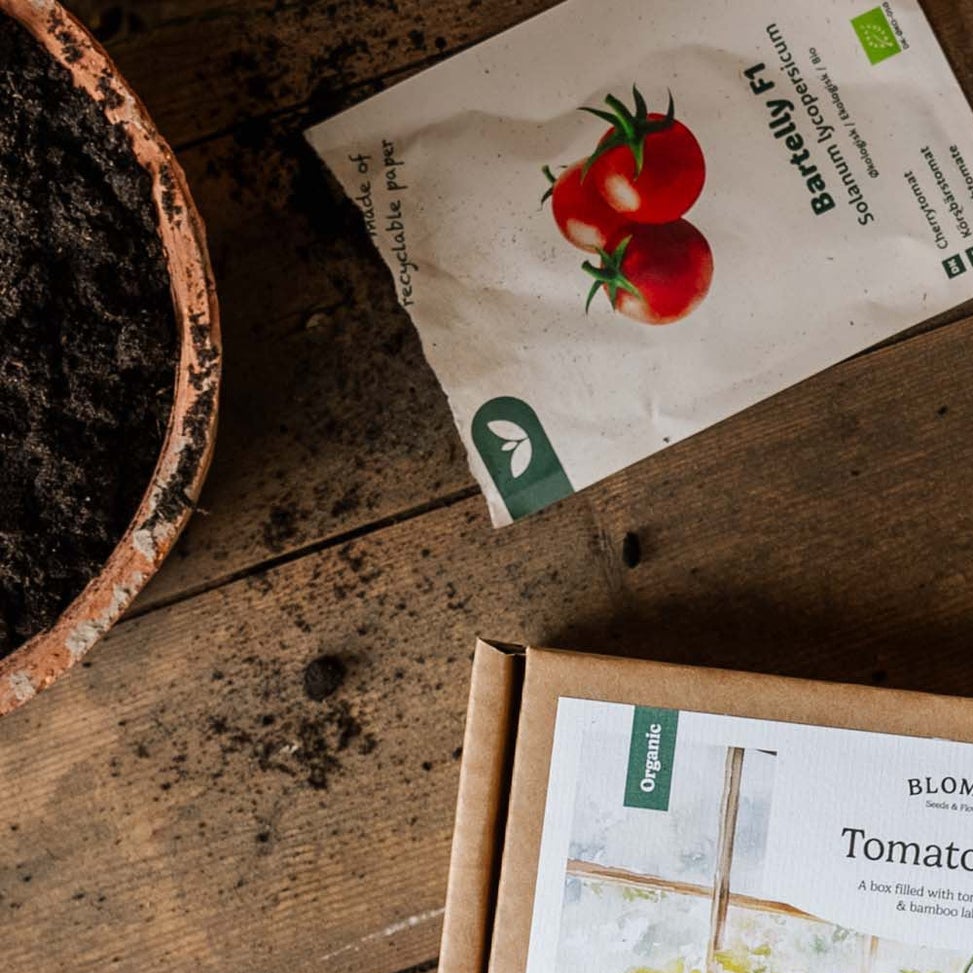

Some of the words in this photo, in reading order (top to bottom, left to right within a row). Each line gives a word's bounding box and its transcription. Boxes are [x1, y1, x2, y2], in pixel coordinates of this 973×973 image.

[743, 63, 775, 95] F1
[809, 47, 821, 65] Bio
[766, 23, 835, 144] lycopersicum
[820, 73, 850, 120] Ekologisk
[348, 153, 371, 173] of
[382, 139, 408, 191] paper
[766, 99, 836, 215] Bartelly
[849, 128, 879, 178] Økologisk
[827, 144, 874, 226] Solanum
[904, 171, 948, 249] Cherrytomat
[920, 146, 972, 239] Körsbärstomat
[385, 200, 418, 307] recyclable
[639, 723, 662, 793] Organic
[925, 800, 949, 810] Seeds
[950, 803, 958, 811] &
[858, 880, 867, 891] A
[870, 881, 892, 894] box
[895, 883, 925, 898] filled
[927, 887, 954, 901] with
[896, 900, 906, 912] &
[910, 902, 959, 918] bamboo
